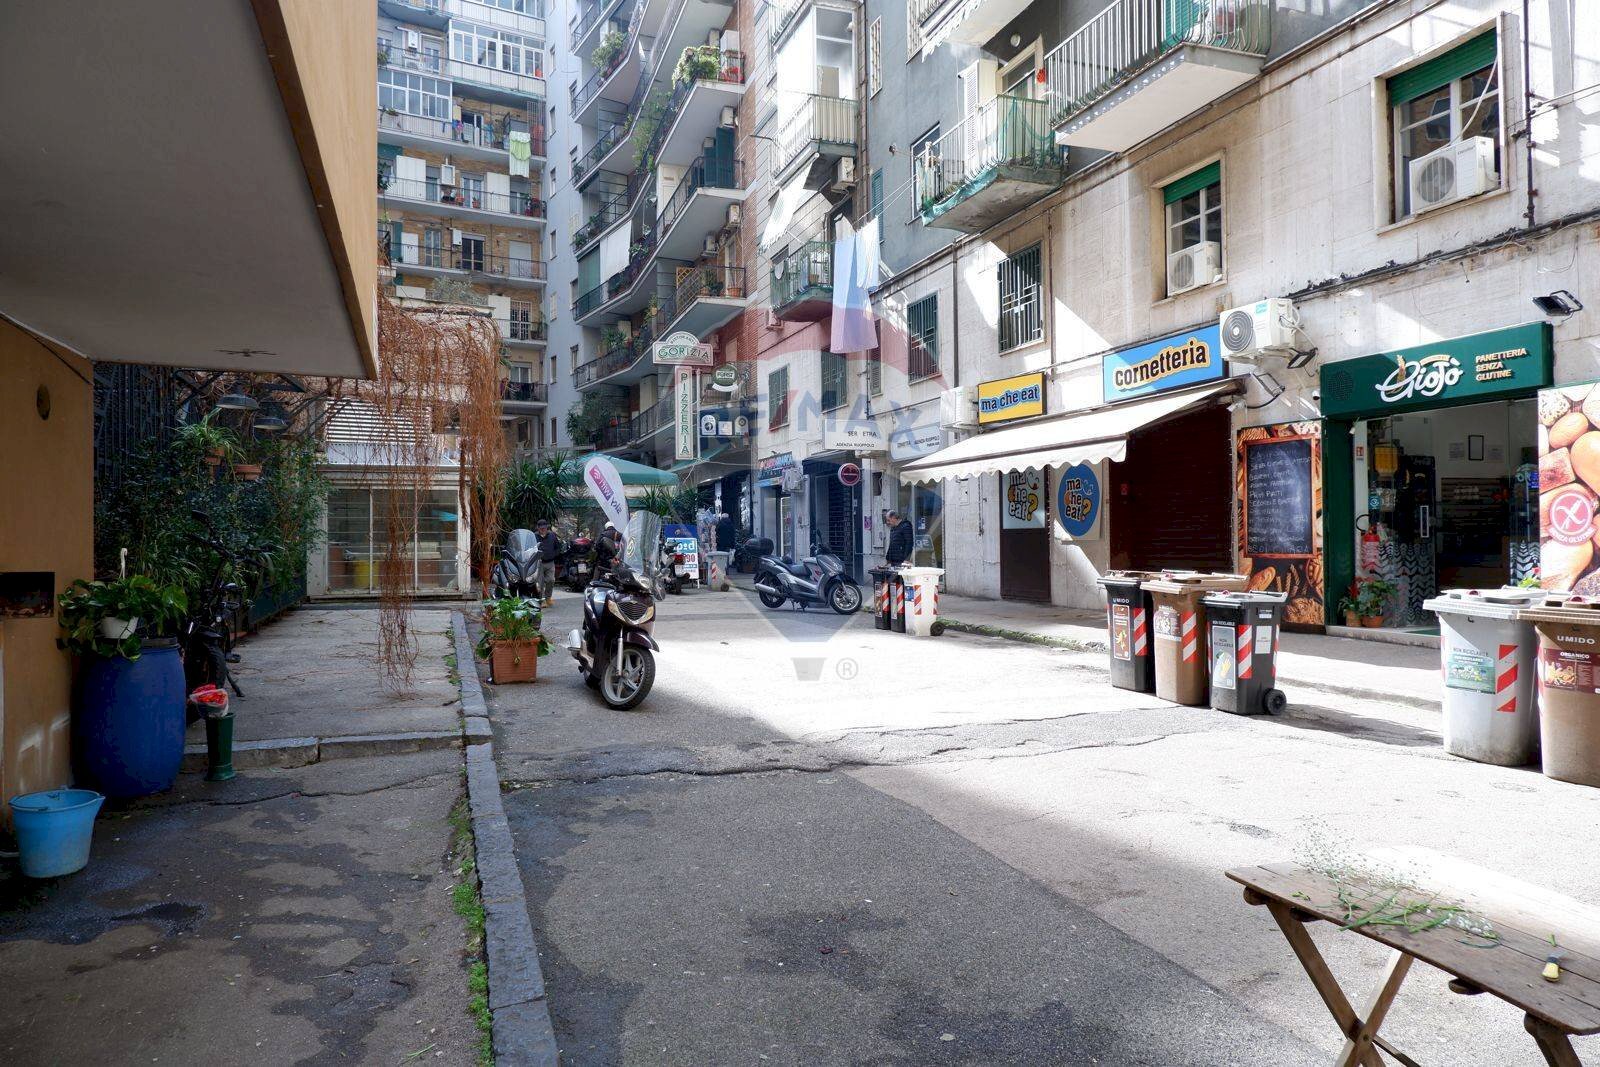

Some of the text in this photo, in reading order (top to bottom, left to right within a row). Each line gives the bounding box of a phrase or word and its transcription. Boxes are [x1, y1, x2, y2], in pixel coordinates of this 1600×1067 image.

[657, 345, 710, 360] GORIZIA
[1475, 347, 1528, 363] PANETTERIA
[1115, 341, 1207, 387] cornetteria
[1475, 361, 1504, 373] SENZA
[1475, 369, 1513, 382] GLUTINE
[981, 386, 1039, 412] ma che eat
[681, 372, 690, 455] PIZZERIA
[1066, 477, 1081, 491] ma
[1557, 635, 1596, 646] UMIDO
[1560, 651, 1590, 659] ORGANICO
